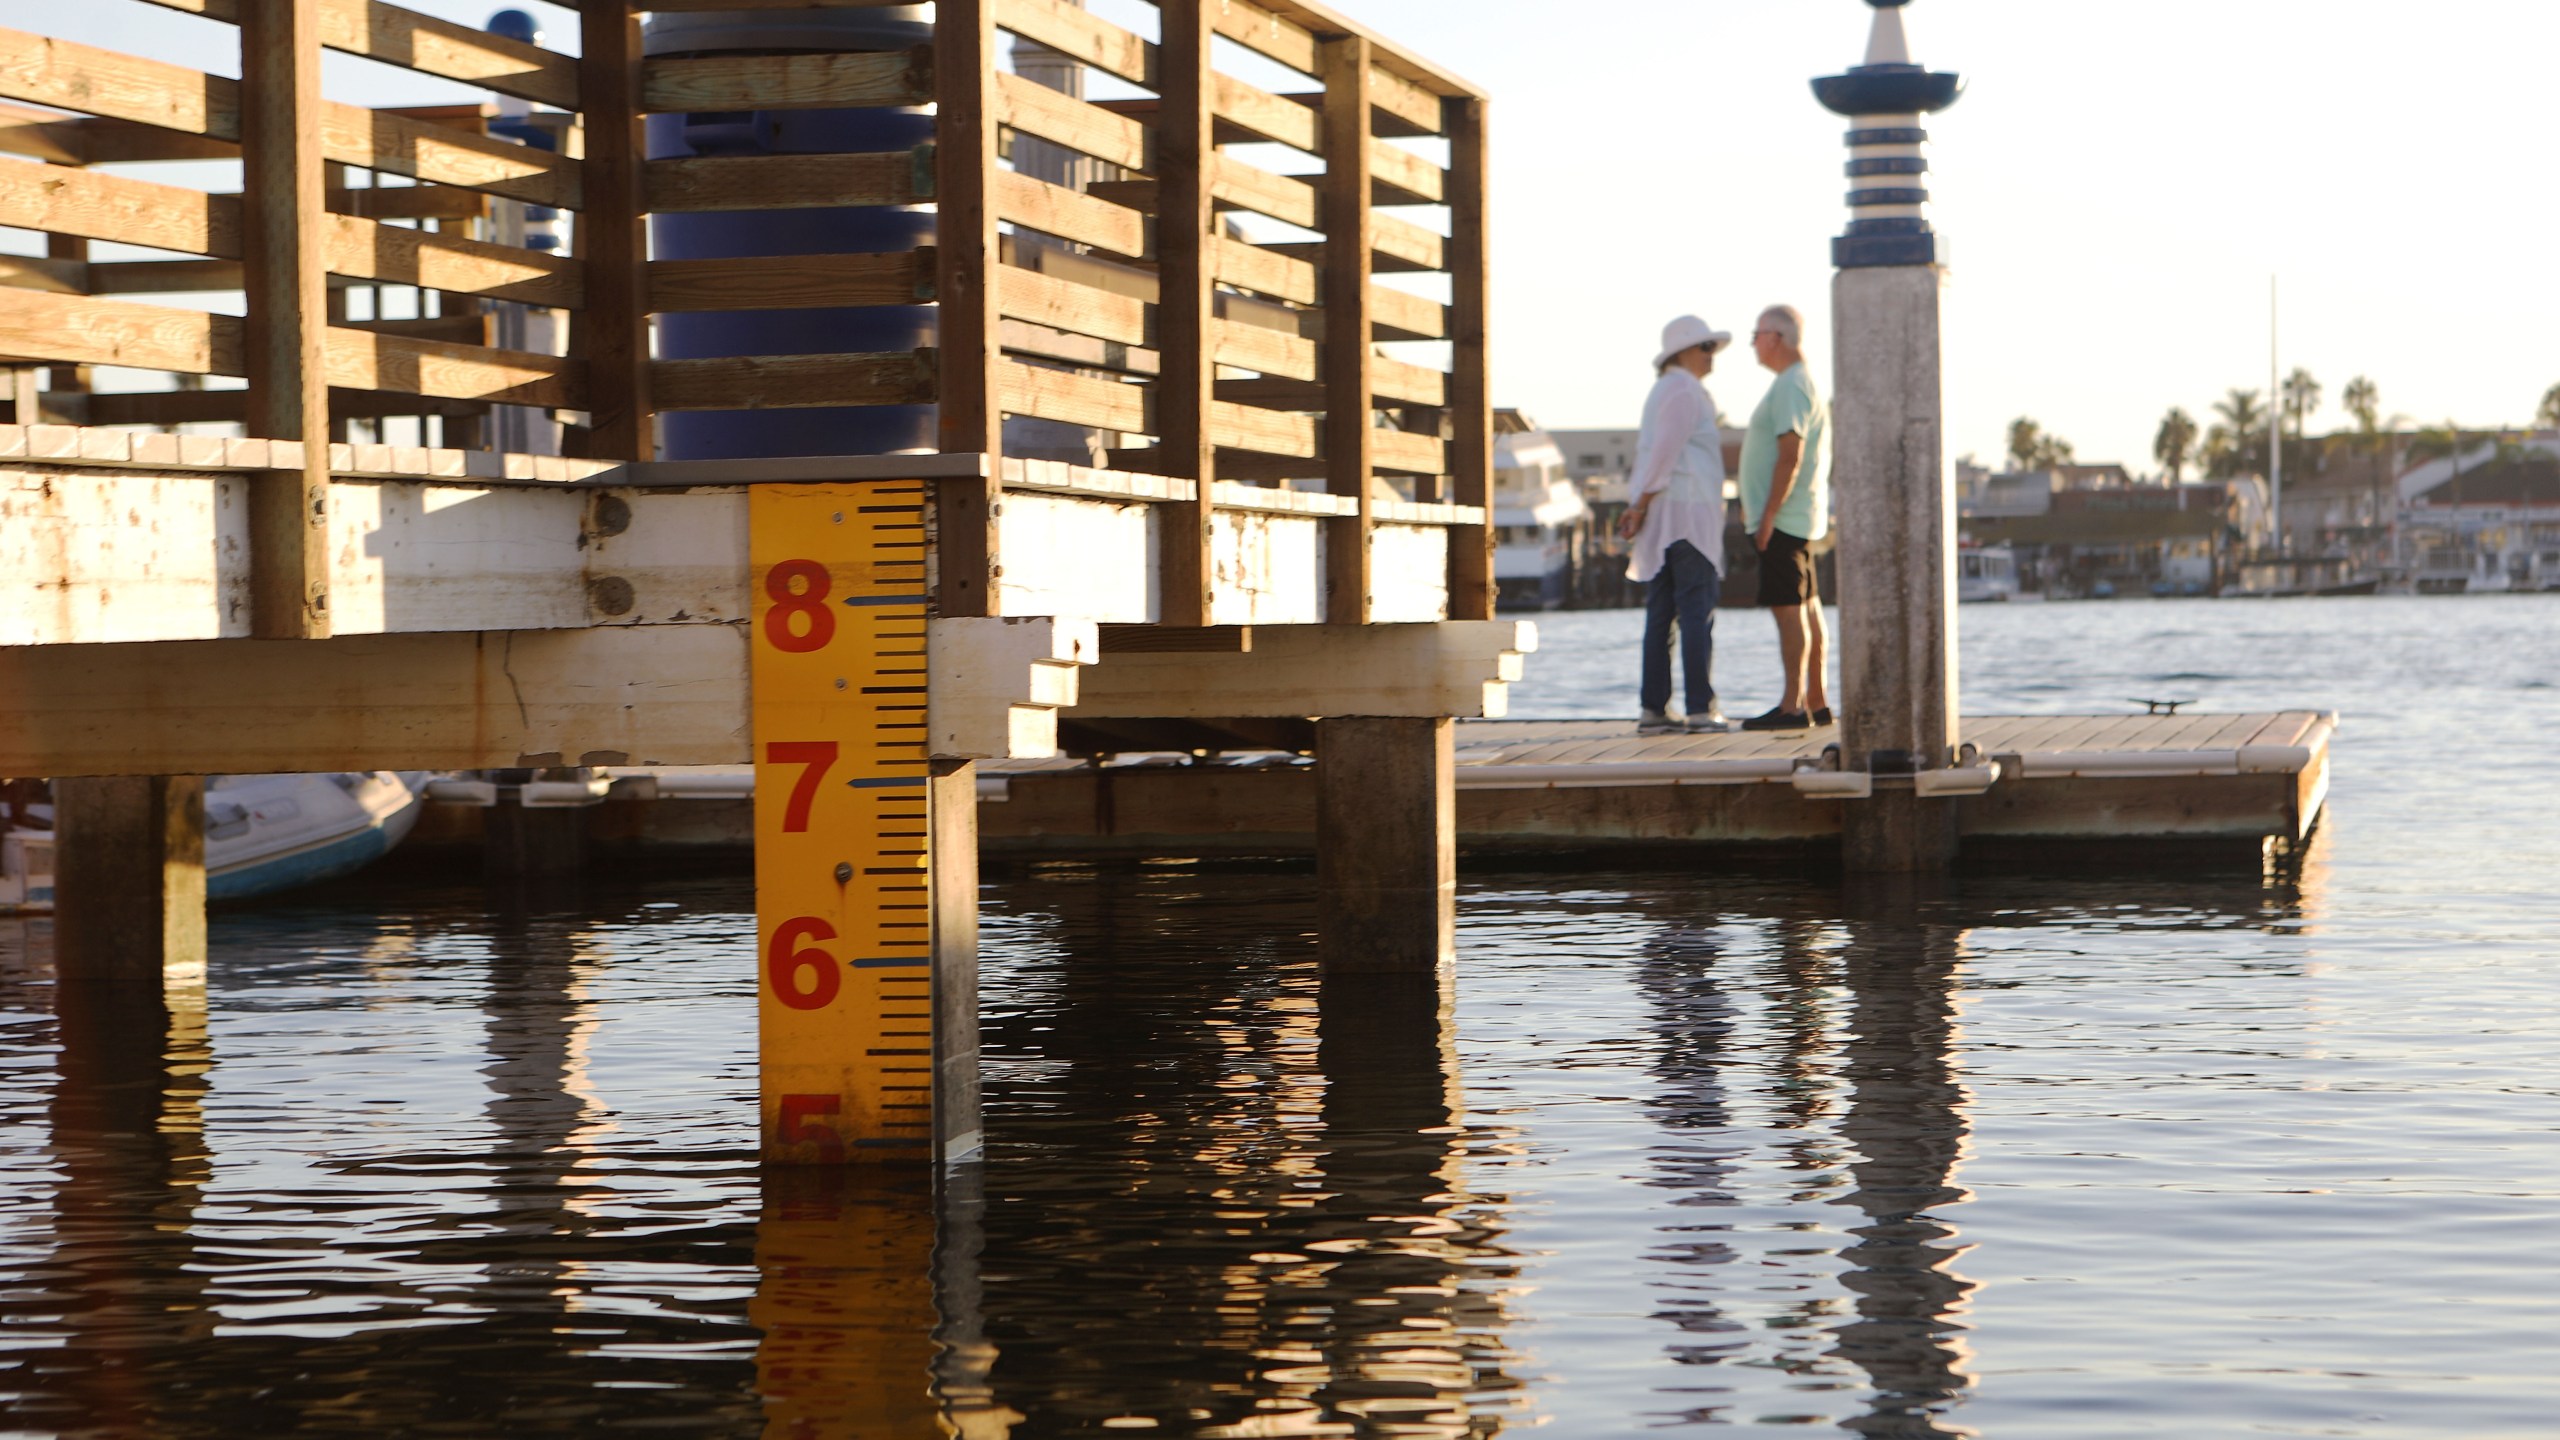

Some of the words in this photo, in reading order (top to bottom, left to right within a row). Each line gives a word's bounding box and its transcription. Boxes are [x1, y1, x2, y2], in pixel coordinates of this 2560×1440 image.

[764, 559, 836, 653] 8
[766, 741, 838, 833] 7
[768, 916, 841, 1011] 6
[776, 1093, 845, 1163] 5
